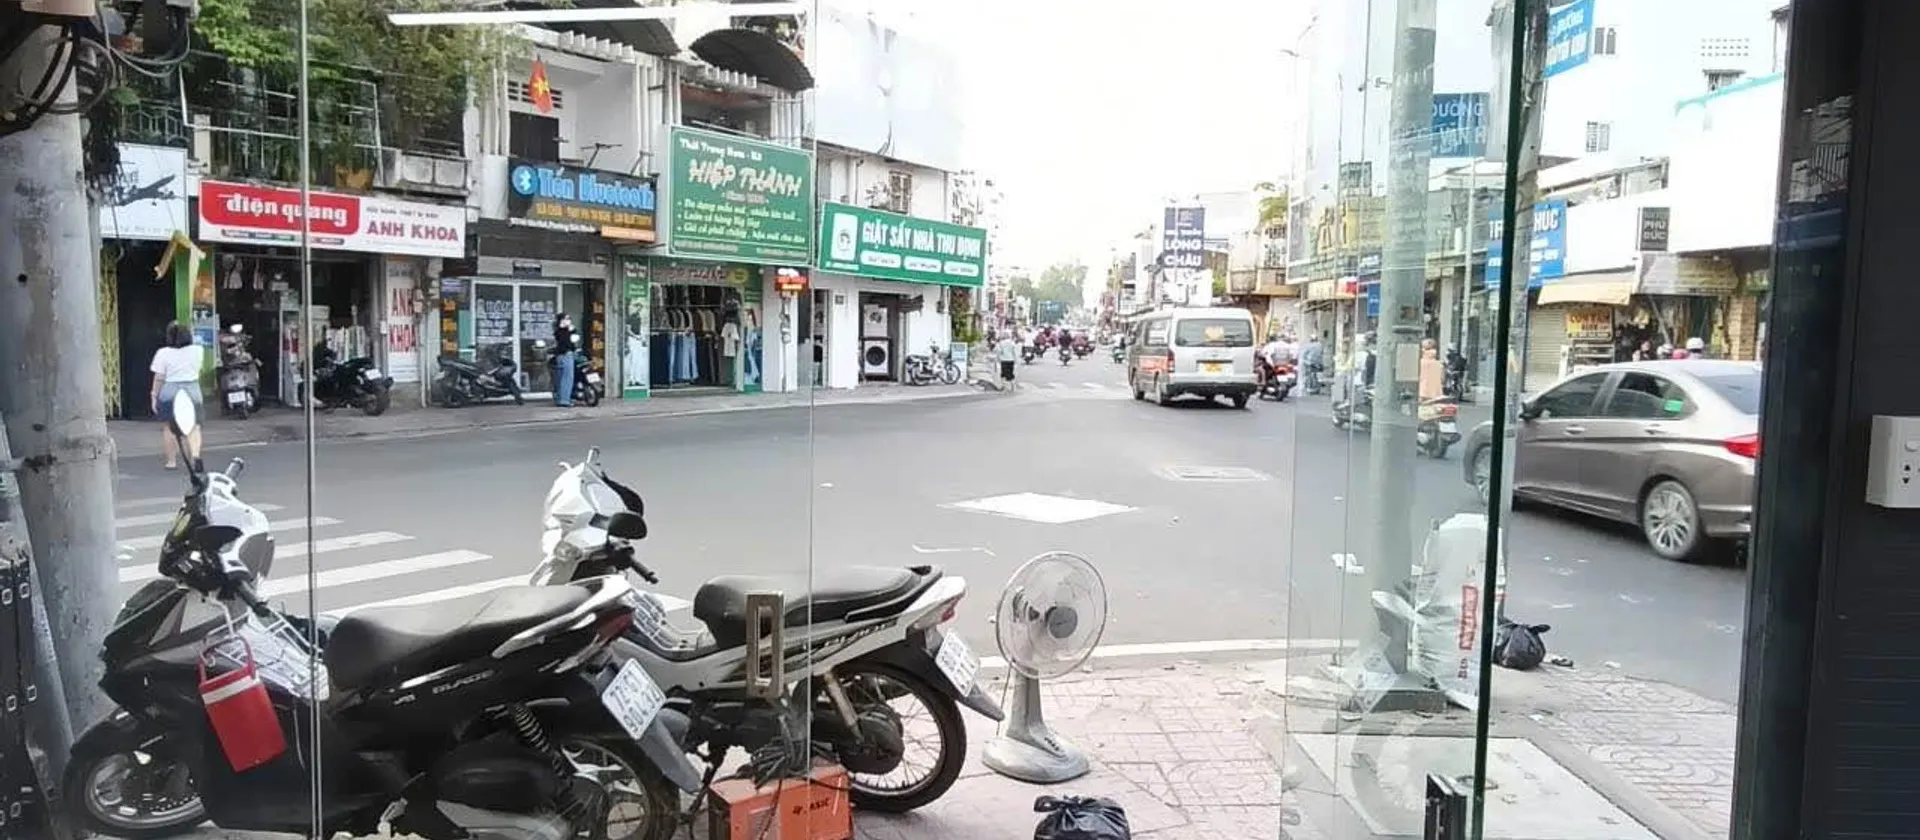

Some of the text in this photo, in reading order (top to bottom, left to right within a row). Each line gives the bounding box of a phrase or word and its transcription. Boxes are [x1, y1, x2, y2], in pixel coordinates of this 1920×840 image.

[537, 167, 655, 210] Tiến Bluetooth
[689, 158, 736, 190] HIỆP
[739, 165, 802, 197] THÀNH
[217, 192, 278, 216] điện
[367, 221, 459, 241] ANH KHOA
[888, 219, 912, 249] SẤY
[1165, 239, 1202, 251] LONG
[1164, 253, 1202, 266] CHÂU
